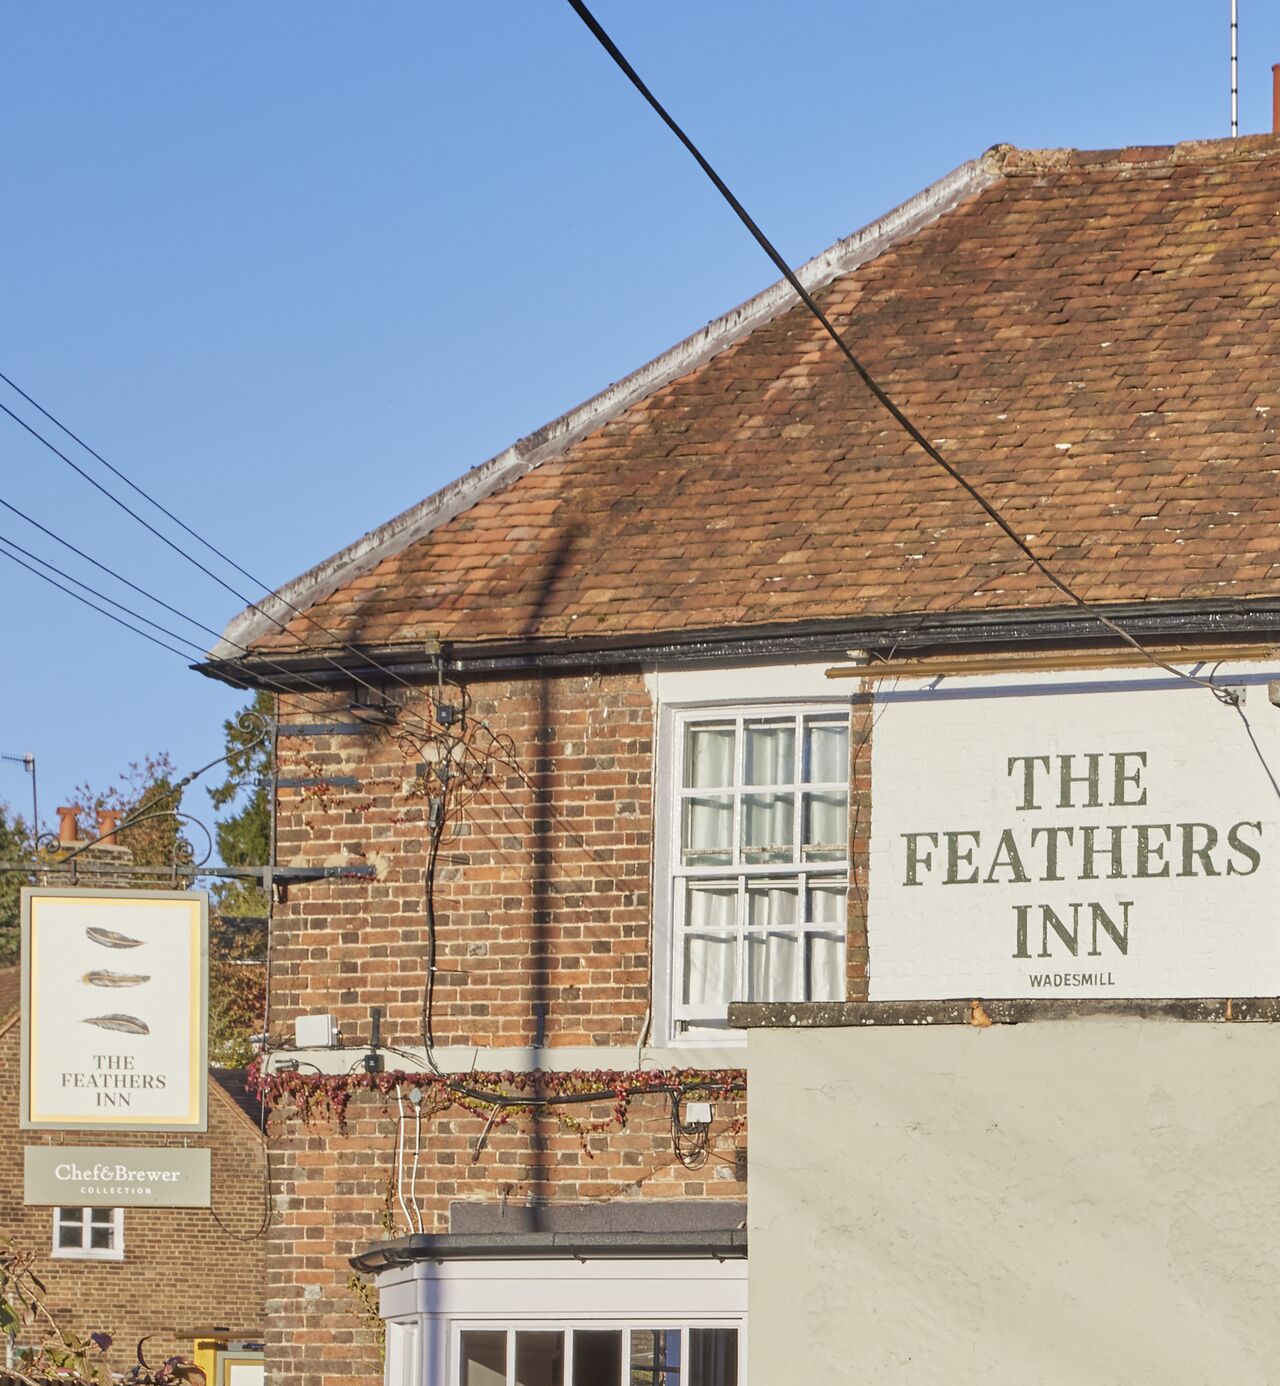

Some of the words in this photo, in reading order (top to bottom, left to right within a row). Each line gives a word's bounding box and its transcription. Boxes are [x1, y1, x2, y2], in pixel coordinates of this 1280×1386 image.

[1007, 751, 1148, 811] THE
[900, 820, 1263, 887] FEATHERS
[1011, 901, 1135, 959] INN
[1029, 972, 1116, 988] WADESMILL
[93, 1055, 135, 1070] THE
[61, 1073, 167, 1089] FEATHERS
[96, 1092, 132, 1107] INN
[55, 1164, 181, 1181] Chef&Brewer
[80, 1186, 152, 1195] COLLECTION
